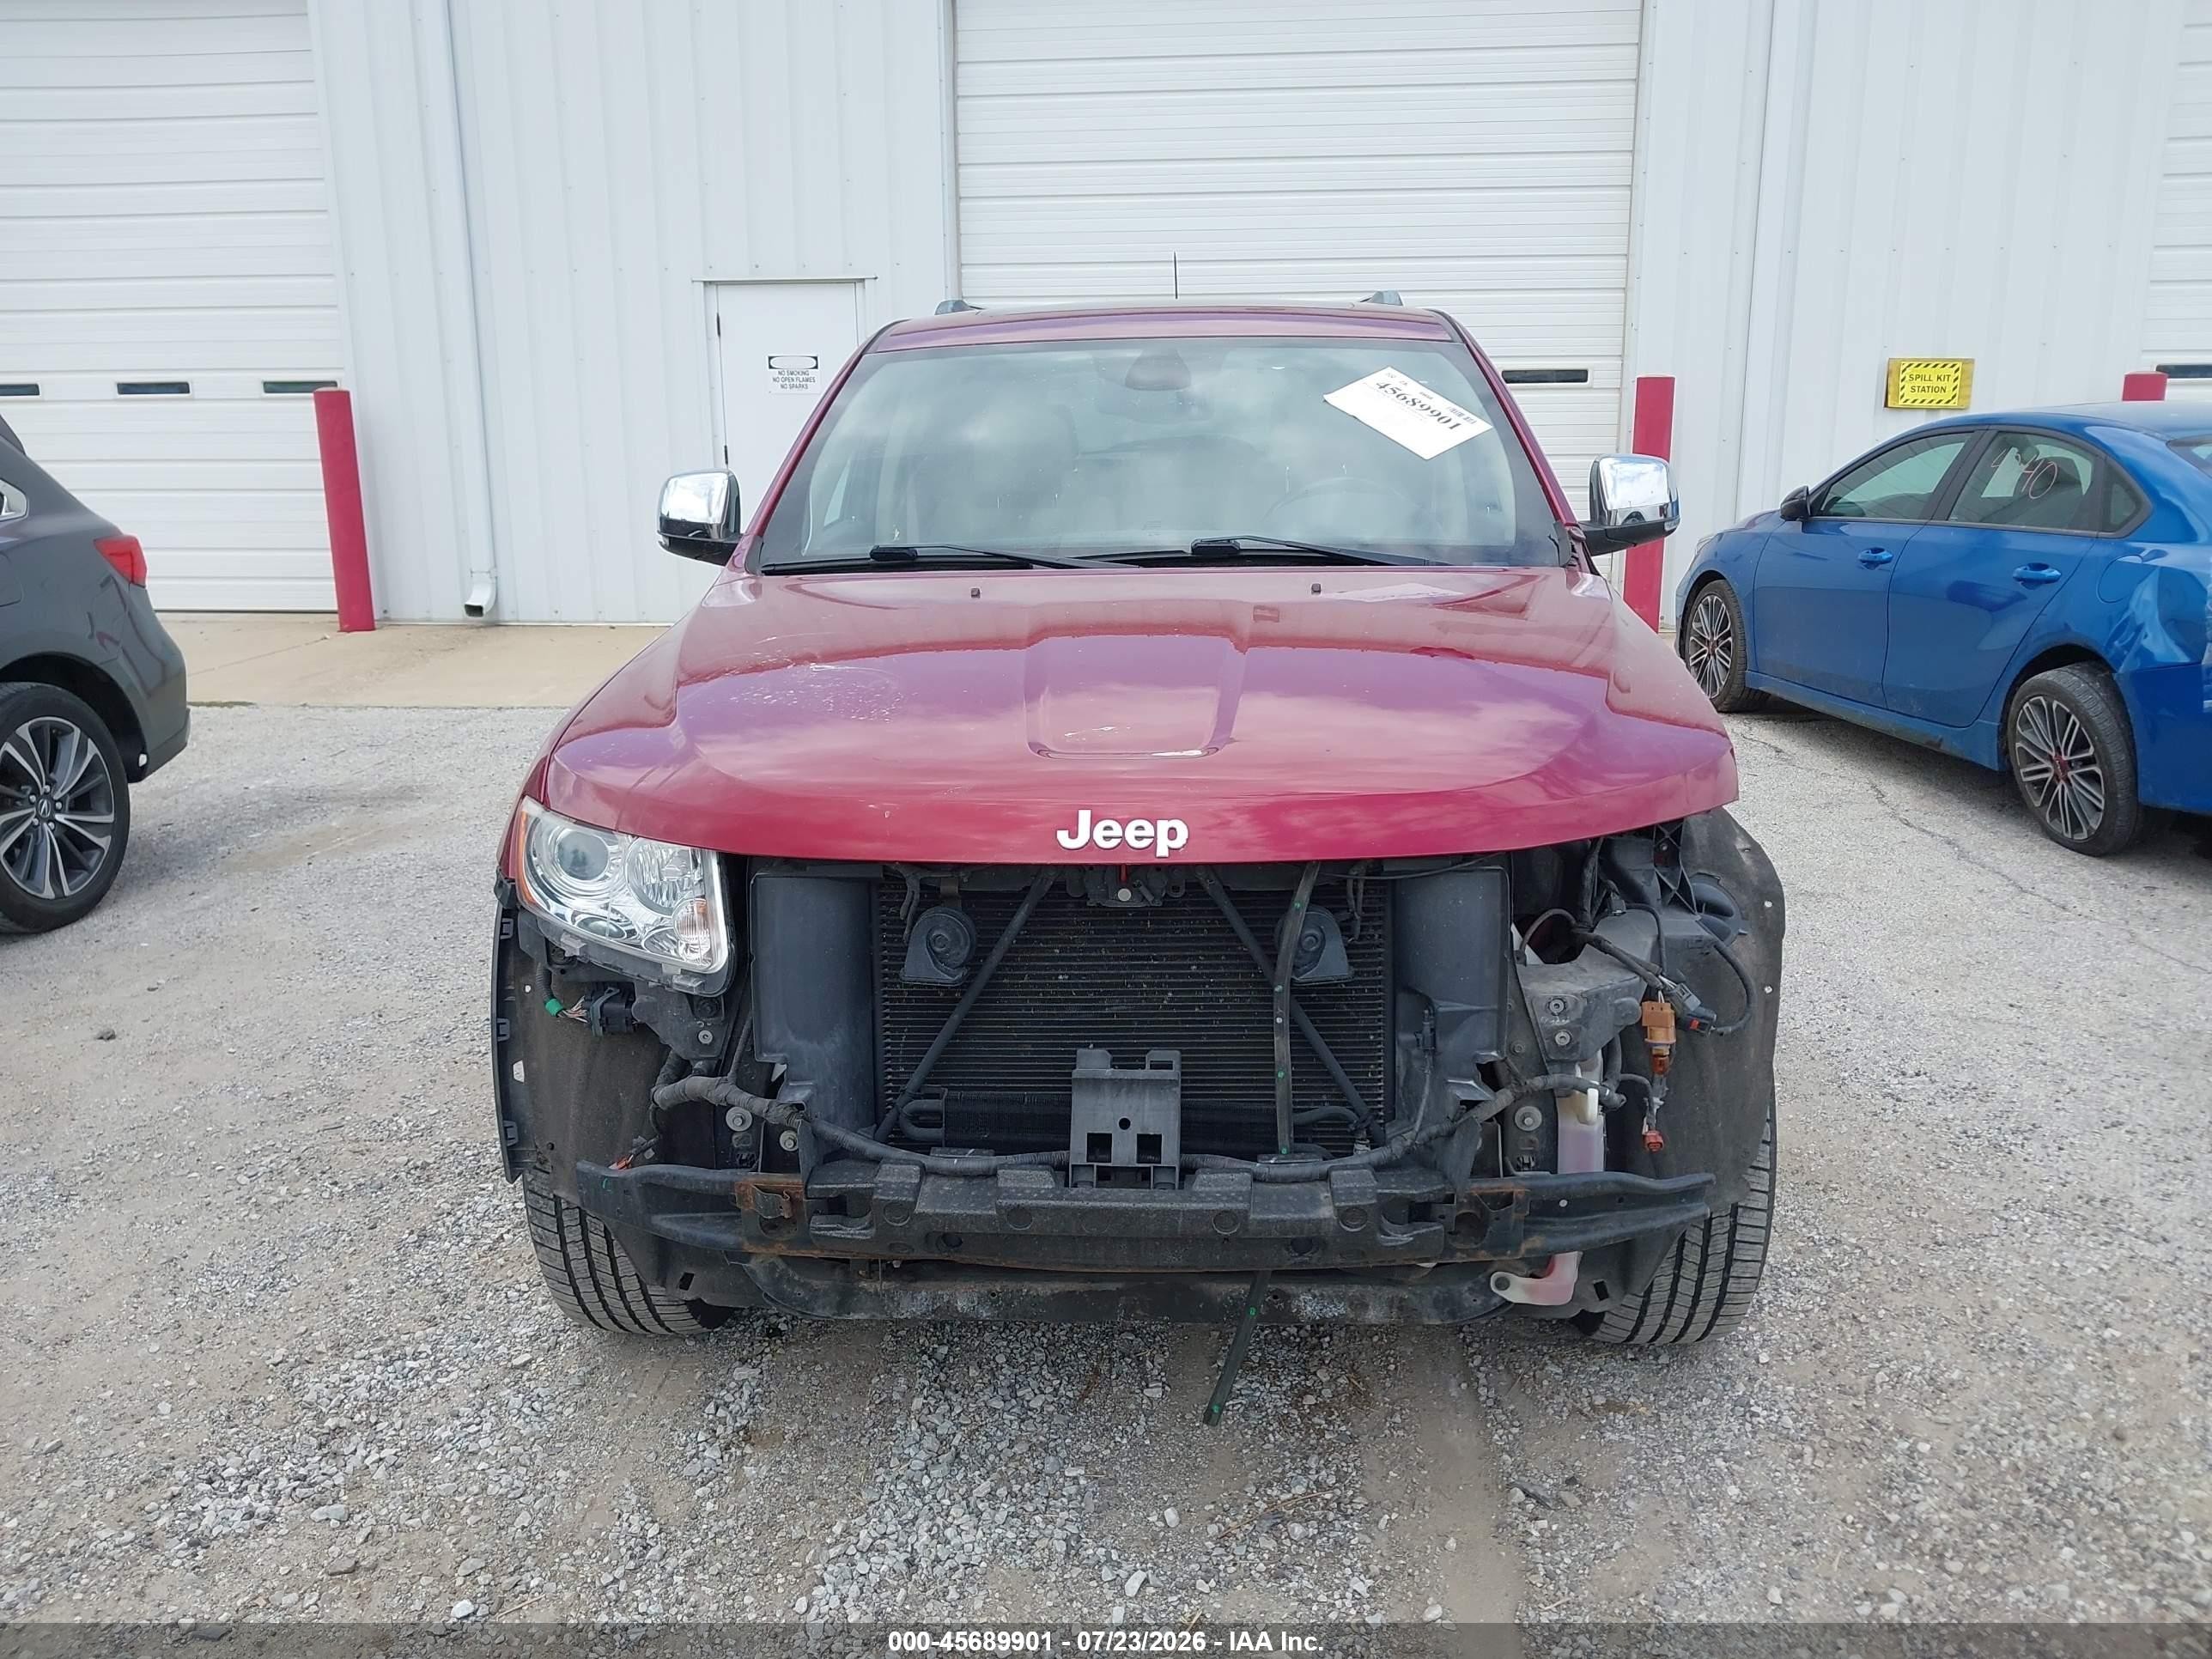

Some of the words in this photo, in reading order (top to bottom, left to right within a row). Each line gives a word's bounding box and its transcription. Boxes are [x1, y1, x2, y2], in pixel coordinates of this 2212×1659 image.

[1909, 374, 1933, 382] SPILL
[1936, 374, 1952, 382] KIT
[1376, 380, 1463, 430] 45689901
[1056, 808, 1189, 859] Jeep
